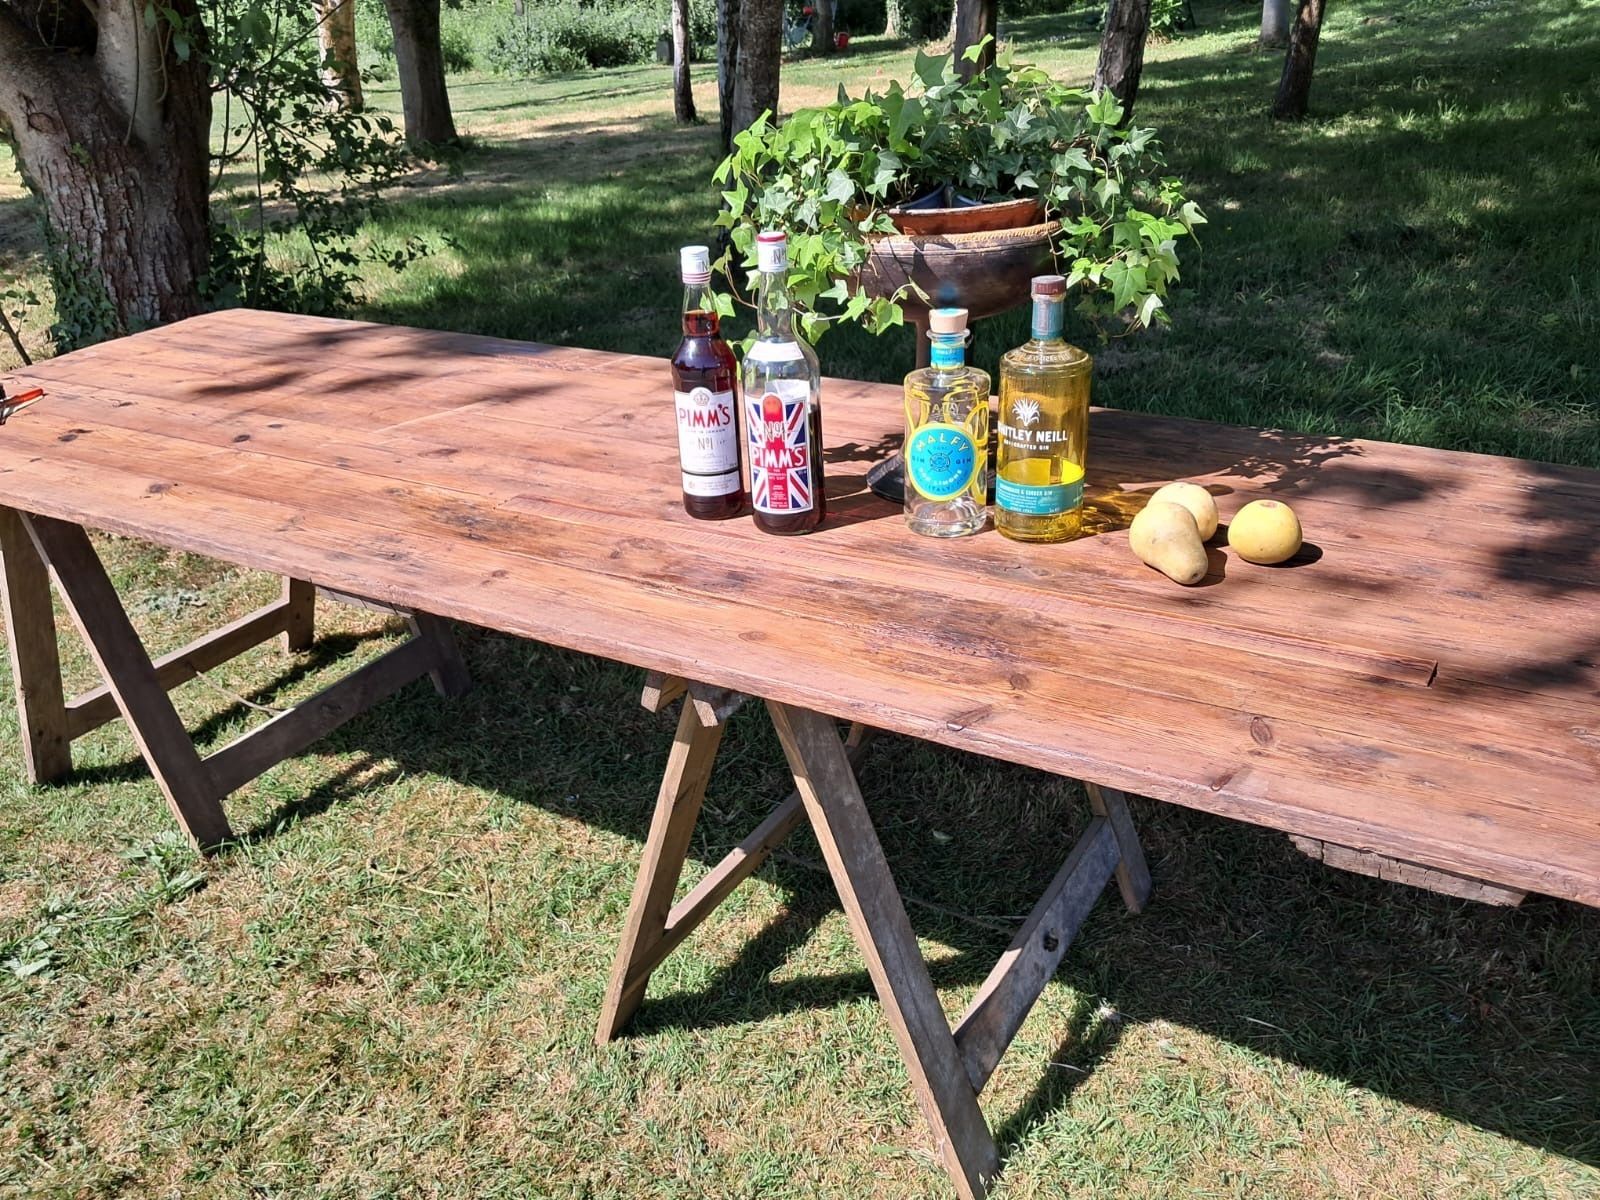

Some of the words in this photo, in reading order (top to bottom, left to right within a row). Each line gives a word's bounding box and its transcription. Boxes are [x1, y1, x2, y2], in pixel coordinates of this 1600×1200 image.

[679, 404, 731, 428] PIMM'S
[916, 432, 968, 451] MALFY
[1036, 430, 1067, 442] NEILL
[752, 446, 804, 468] PIMM'S
